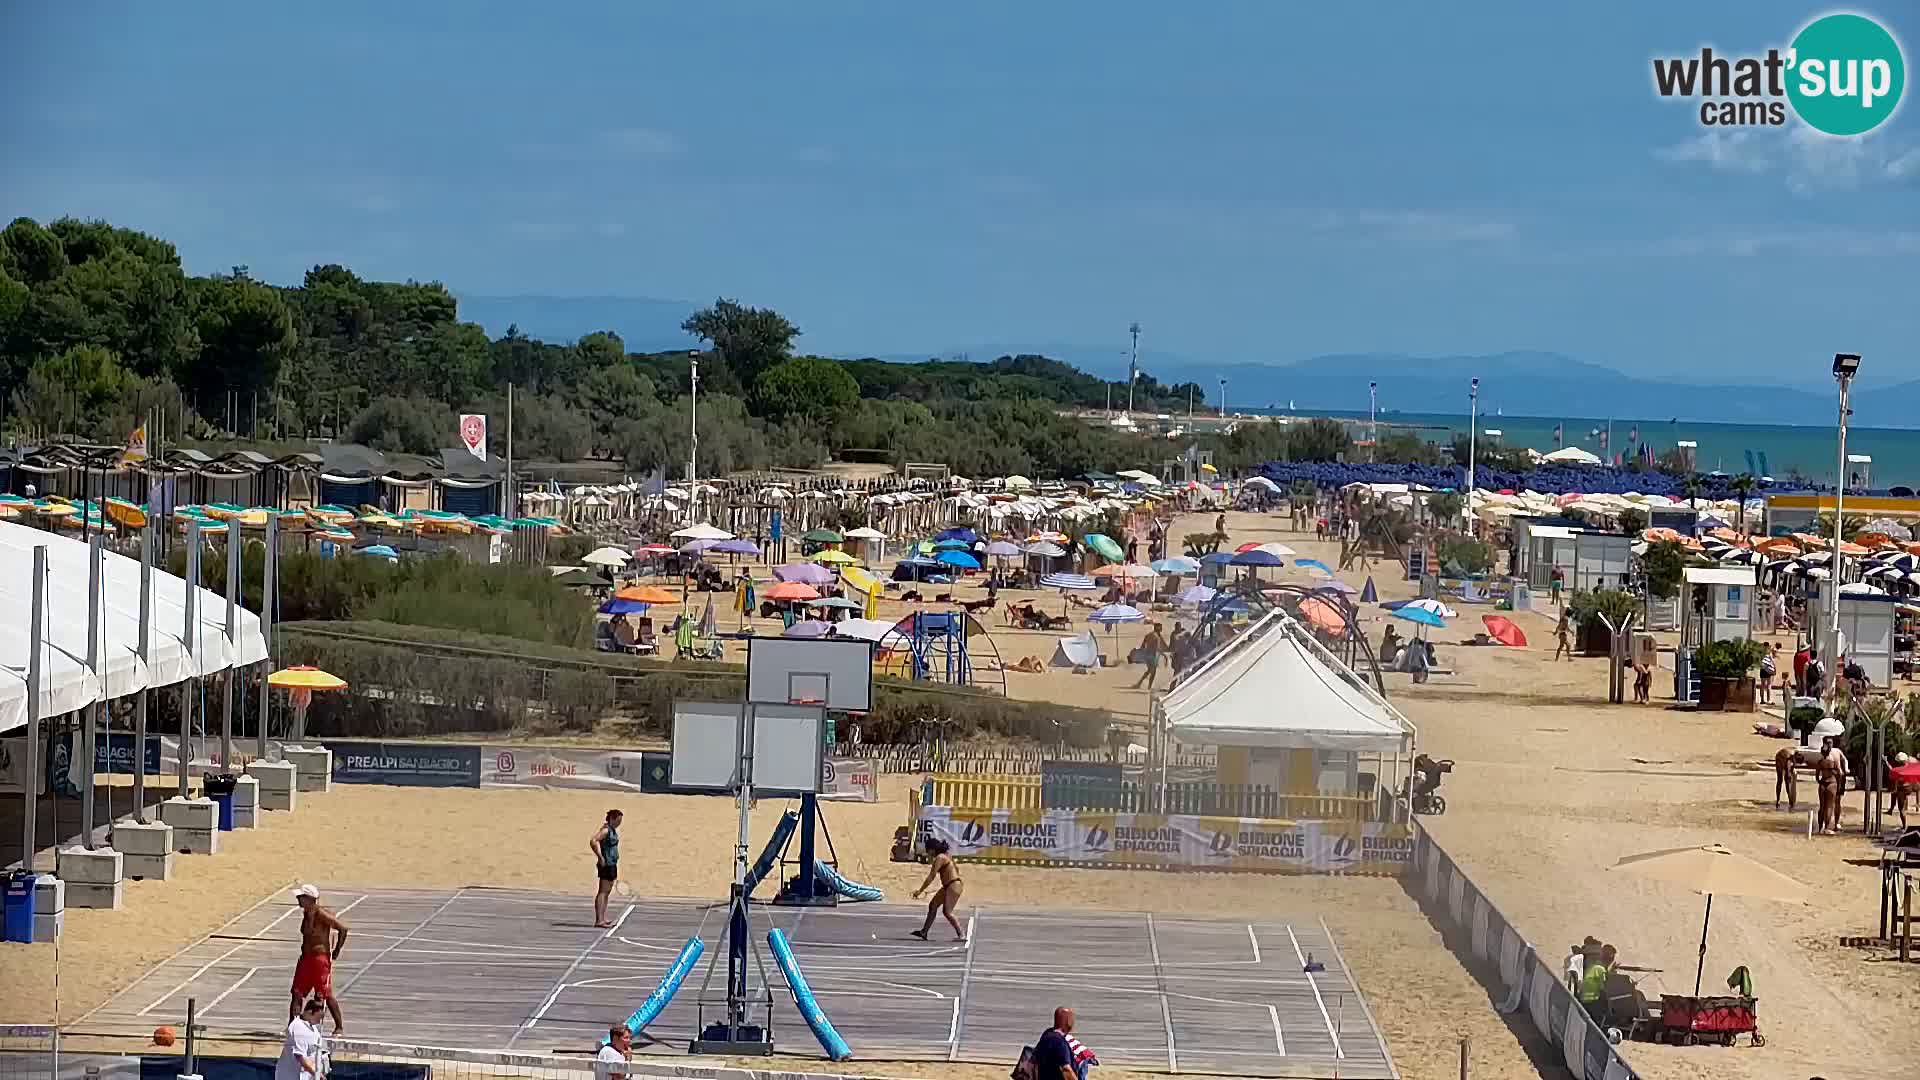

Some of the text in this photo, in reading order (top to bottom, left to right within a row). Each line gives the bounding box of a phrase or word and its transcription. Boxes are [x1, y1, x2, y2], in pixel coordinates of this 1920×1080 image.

[991, 822, 1057, 836] BIBIONE
[1114, 826, 1183, 841] BIBIONE
[991, 835, 1057, 849] SPIAGGIA
[1238, 831, 1305, 847] BIBIONE
